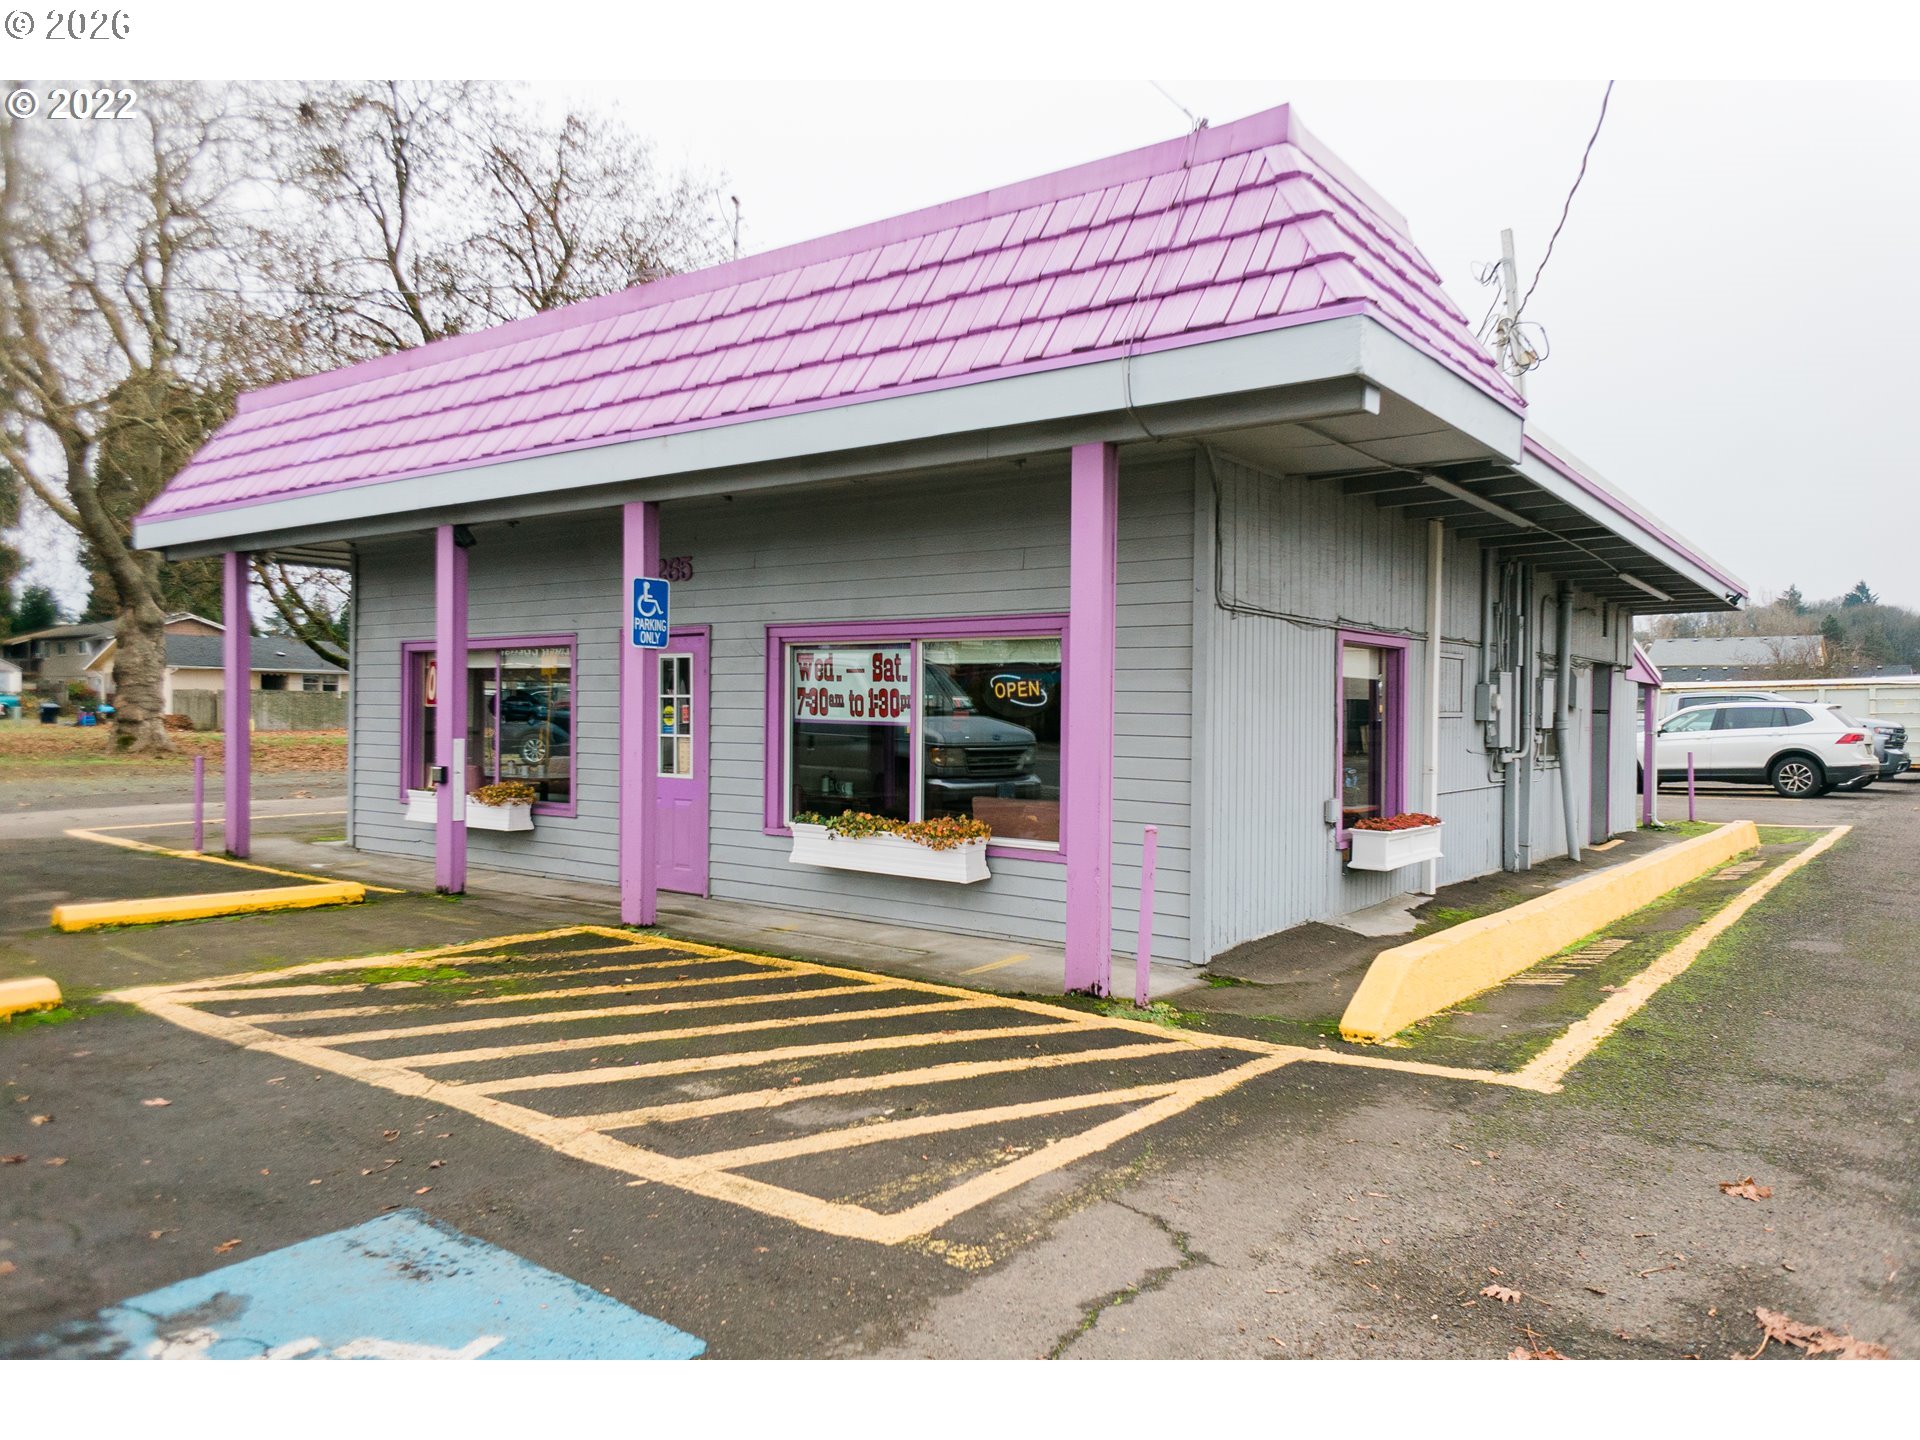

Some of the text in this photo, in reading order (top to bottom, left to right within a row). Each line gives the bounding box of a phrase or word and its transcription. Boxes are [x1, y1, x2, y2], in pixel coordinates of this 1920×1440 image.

[635, 617, 667, 632] PARKING
[640, 631, 661, 644] ONLY
[797, 653, 842, 682] Wed.
[873, 652, 908, 682] Sat.
[995, 680, 1040, 698] OPEN
[797, 687, 845, 716] 7:30am
[849, 690, 864, 717] to
